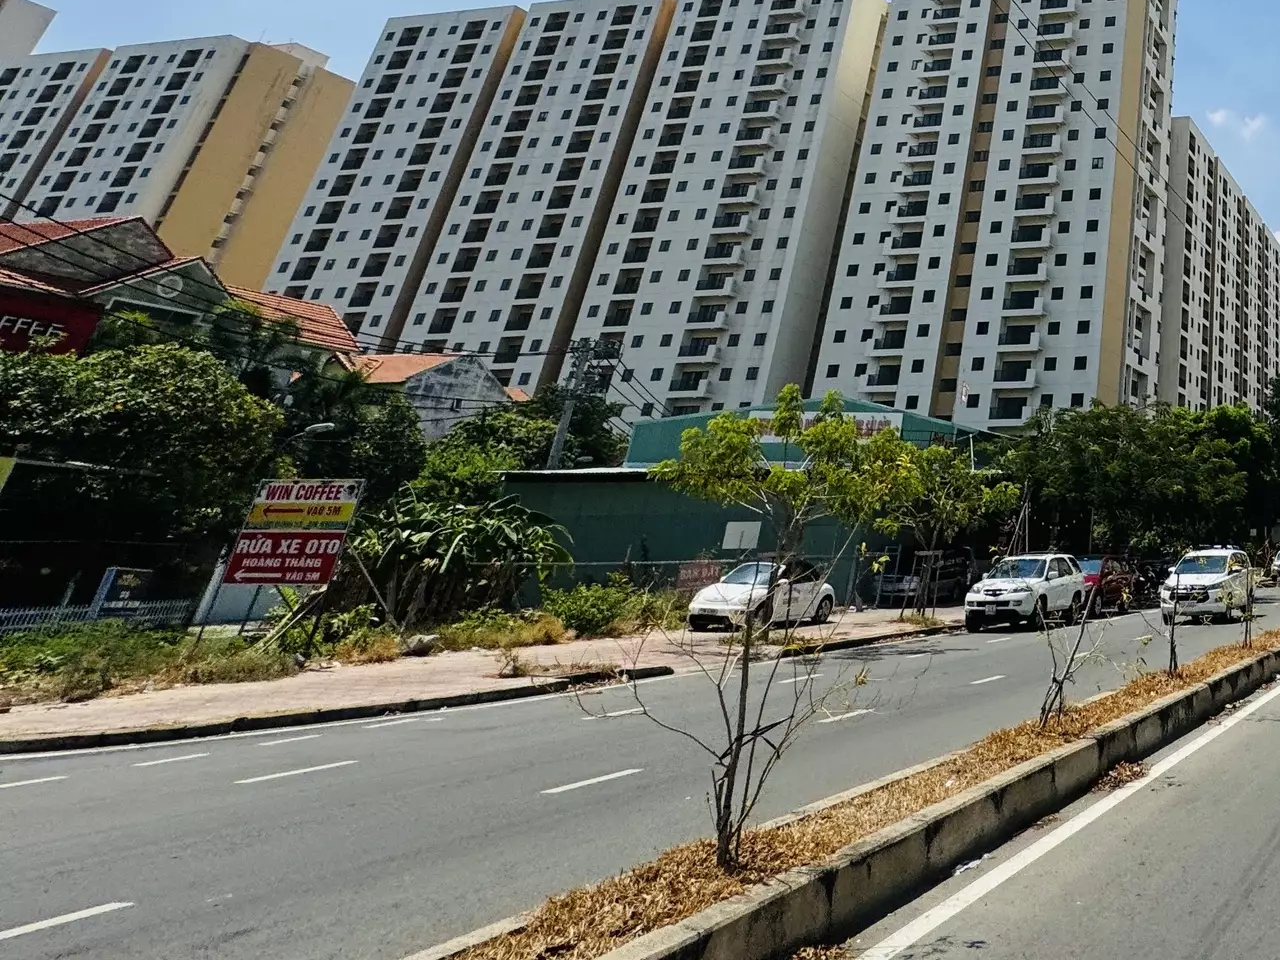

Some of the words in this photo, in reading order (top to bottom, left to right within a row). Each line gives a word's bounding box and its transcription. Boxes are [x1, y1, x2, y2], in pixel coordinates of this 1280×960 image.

[266, 484, 295, 501] WIN
[295, 484, 345, 501] COFFEE
[325, 505, 342, 516] 5M
[275, 539, 303, 554] XE
[304, 571, 321, 581] 5M
